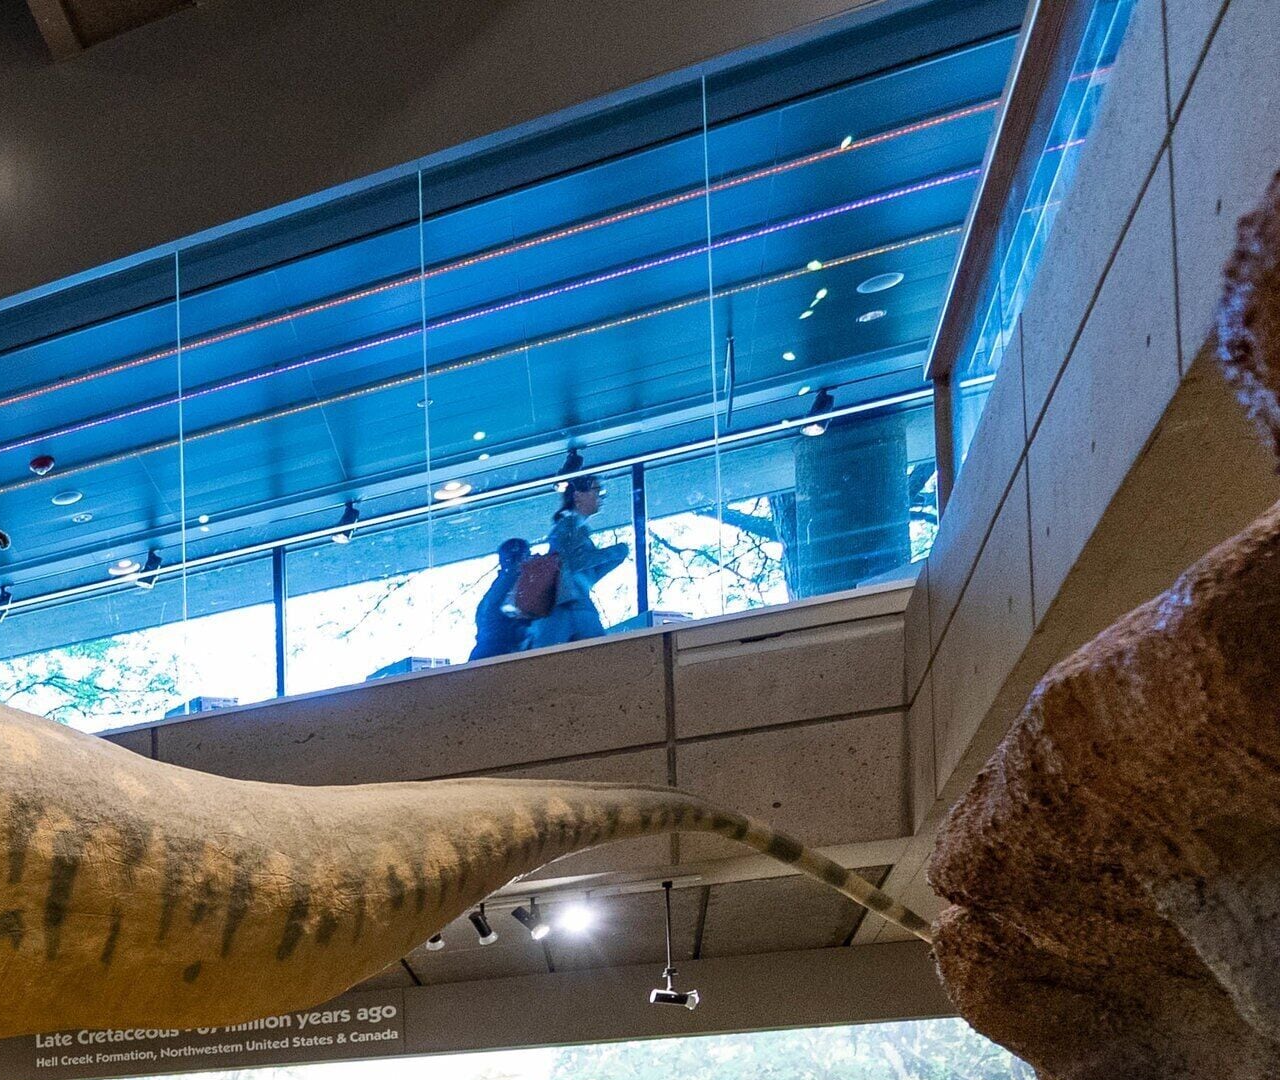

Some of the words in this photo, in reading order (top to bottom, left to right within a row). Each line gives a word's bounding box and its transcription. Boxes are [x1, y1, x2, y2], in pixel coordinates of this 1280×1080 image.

[35, 1032, 72, 1049] Late
[77, 1028, 180, 1045] Cretaceous
[296, 1010, 351, 1029] years
[357, 1004, 397, 1024] ago
[36, 1056, 58, 1067] Hell
[60, 1054, 93, 1065] Creek
[95, 1050, 157, 1062] Formation,
[160, 1043, 243, 1057] Northwestern
[245, 1037, 289, 1051] United
[292, 1035, 333, 1047] States
[336, 1032, 346, 1043] &
[349, 1028, 398, 1042] Canada
